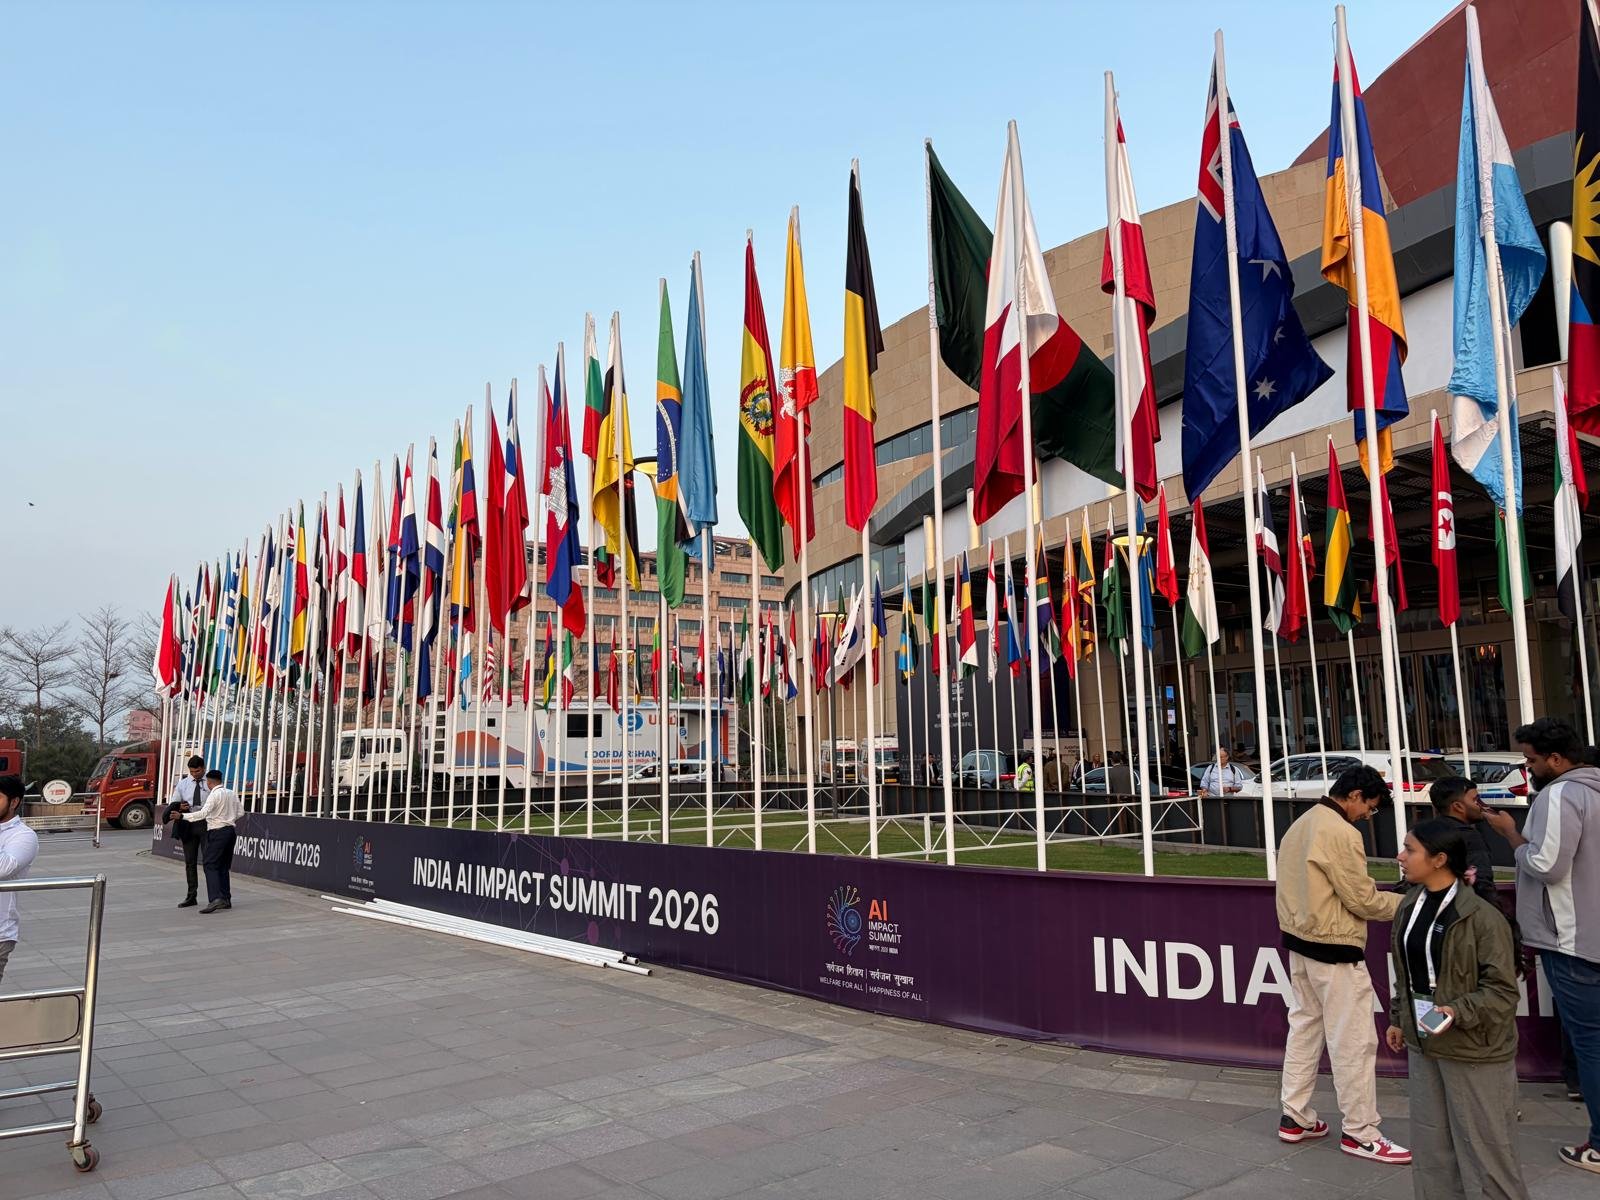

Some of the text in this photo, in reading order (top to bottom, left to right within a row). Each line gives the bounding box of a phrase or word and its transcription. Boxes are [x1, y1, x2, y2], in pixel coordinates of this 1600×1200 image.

[259, 838, 295, 864] SUMMIT
[295, 842, 321, 868] 2026
[413, 856, 720, 935] INDIA AI IMPACT SUMMIT 2026
[868, 899, 888, 921] AI
[868, 921, 899, 934] IMPACT
[868, 931, 902, 944] SUMMIT
[1093, 936, 1293, 1008] INDIA
[819, 976, 923, 1002] WELFARE FOR ALL HAPPINESS OF ALL
